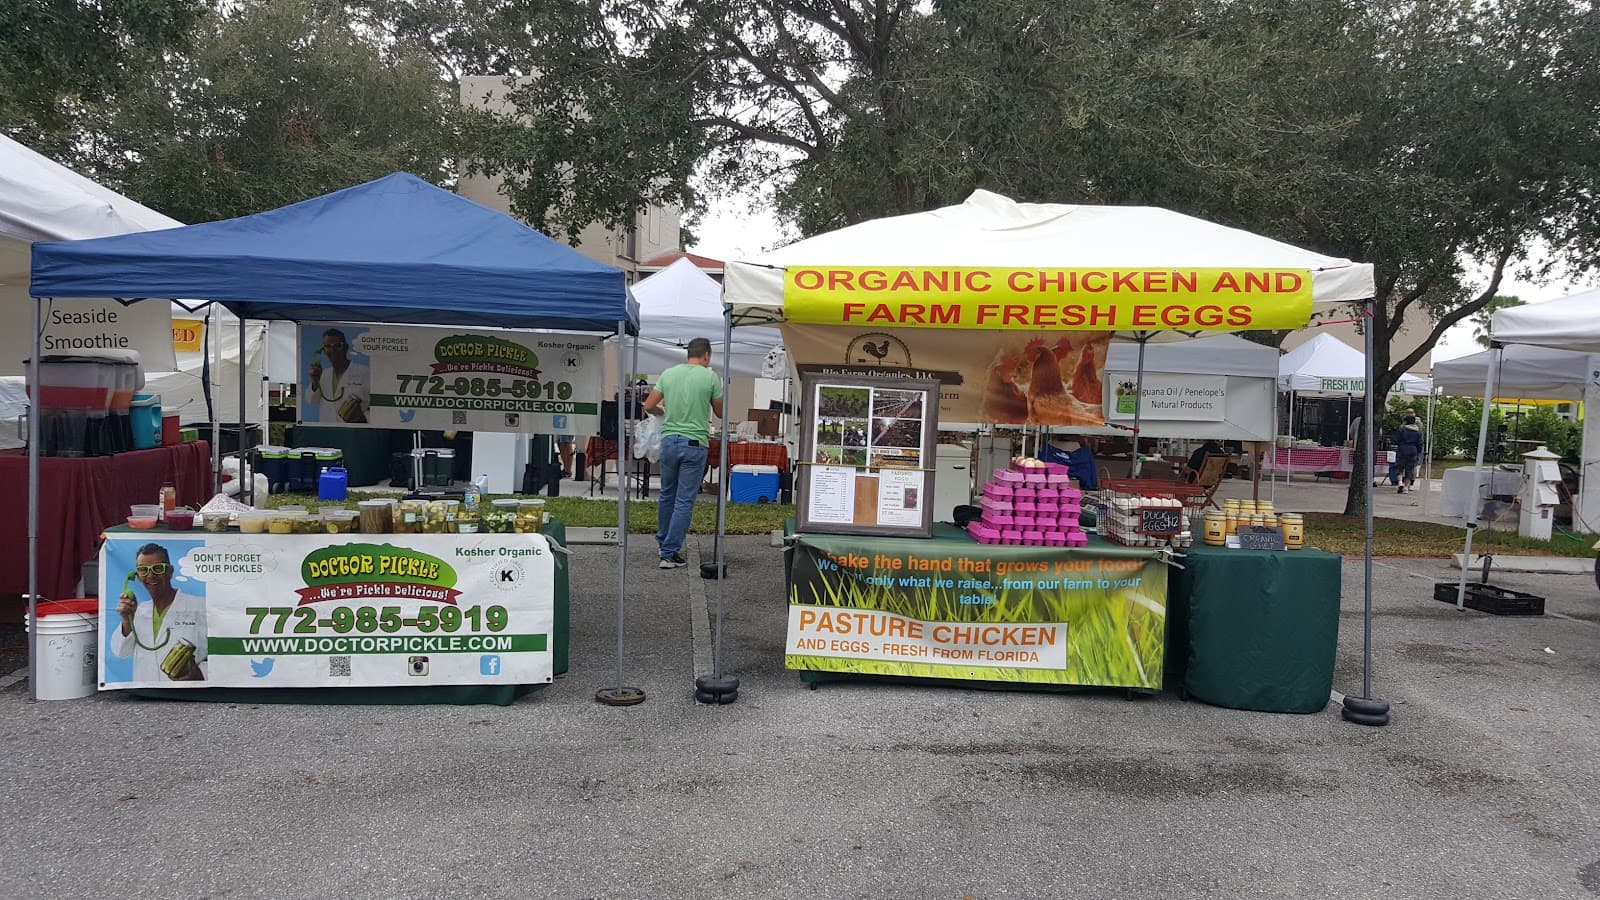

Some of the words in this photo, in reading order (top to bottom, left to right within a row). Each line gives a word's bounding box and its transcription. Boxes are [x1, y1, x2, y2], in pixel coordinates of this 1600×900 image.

[793, 270, 992, 292] ORGANIC
[1007, 271, 1197, 292] CHICKEN
[1211, 271, 1303, 293] AND
[52, 308, 118, 325] Seaside
[842, 303, 961, 323] FARM
[976, 304, 1117, 326] FRESH
[1132, 304, 1253, 326] EGGS
[44, 333, 129, 350] Smoothie
[538, 341, 565, 349] Kosher
[567, 342, 595, 351] Organic
[439, 343, 484, 357] DOCTOR
[487, 343, 527, 362] PICKLE
[471, 363, 494, 371] Pickle
[396, 374, 573, 400] 772-985-5919
[1142, 388, 1165, 397] guana
[1166, 387, 1178, 396] Oil
[1184, 387, 1225, 397] Penelope's
[1321, 379, 1348, 391] FRESH
[393, 395, 575, 413] WWW.DOCTORPICKLE.COM
[1151, 400, 1178, 409] Natural
[1180, 400, 1213, 409] Products
[603, 530, 617, 540] 52
[193, 553, 222, 562] DON'T
[224, 553, 261, 562] FORGET
[455, 547, 496, 557] Kosher
[498, 547, 542, 558] Organic
[195, 563, 221, 573] YOUR
[223, 563, 263, 573] PICKLES
[308, 554, 374, 579] DOCTOR
[379, 554, 440, 580] PICKLE
[873, 554, 902, 571] the
[907, 555, 953, 571] hand
[957, 557, 992, 573] that
[996, 559, 1049, 575] grows
[1054, 559, 1093, 576] your
[817, 558, 839, 571] We
[865, 575, 895, 588] only
[898, 575, 931, 588] what
[934, 578, 954, 588] we
[1037, 579, 1060, 589] our
[1063, 578, 1093, 590] farm
[1097, 578, 1110, 589] to
[1112, 577, 1142, 590] your
[309, 584, 353, 601] ...We're
[355, 584, 391, 597] Pickle
[394, 585, 449, 600] Delicious!
[245, 605, 509, 634] 772-985-5919
[799, 610, 924, 639] PASTURE
[932, 626, 1057, 646] CHICKEN
[242, 636, 513, 653] WWW.DOCTORPICKLE.COM
[796, 638, 827, 650] AND
[830, 640, 870, 653] EGGS
[882, 643, 928, 656] FRESH
[932, 647, 973, 660] FROM
[977, 649, 1040, 663] FLORIDA
